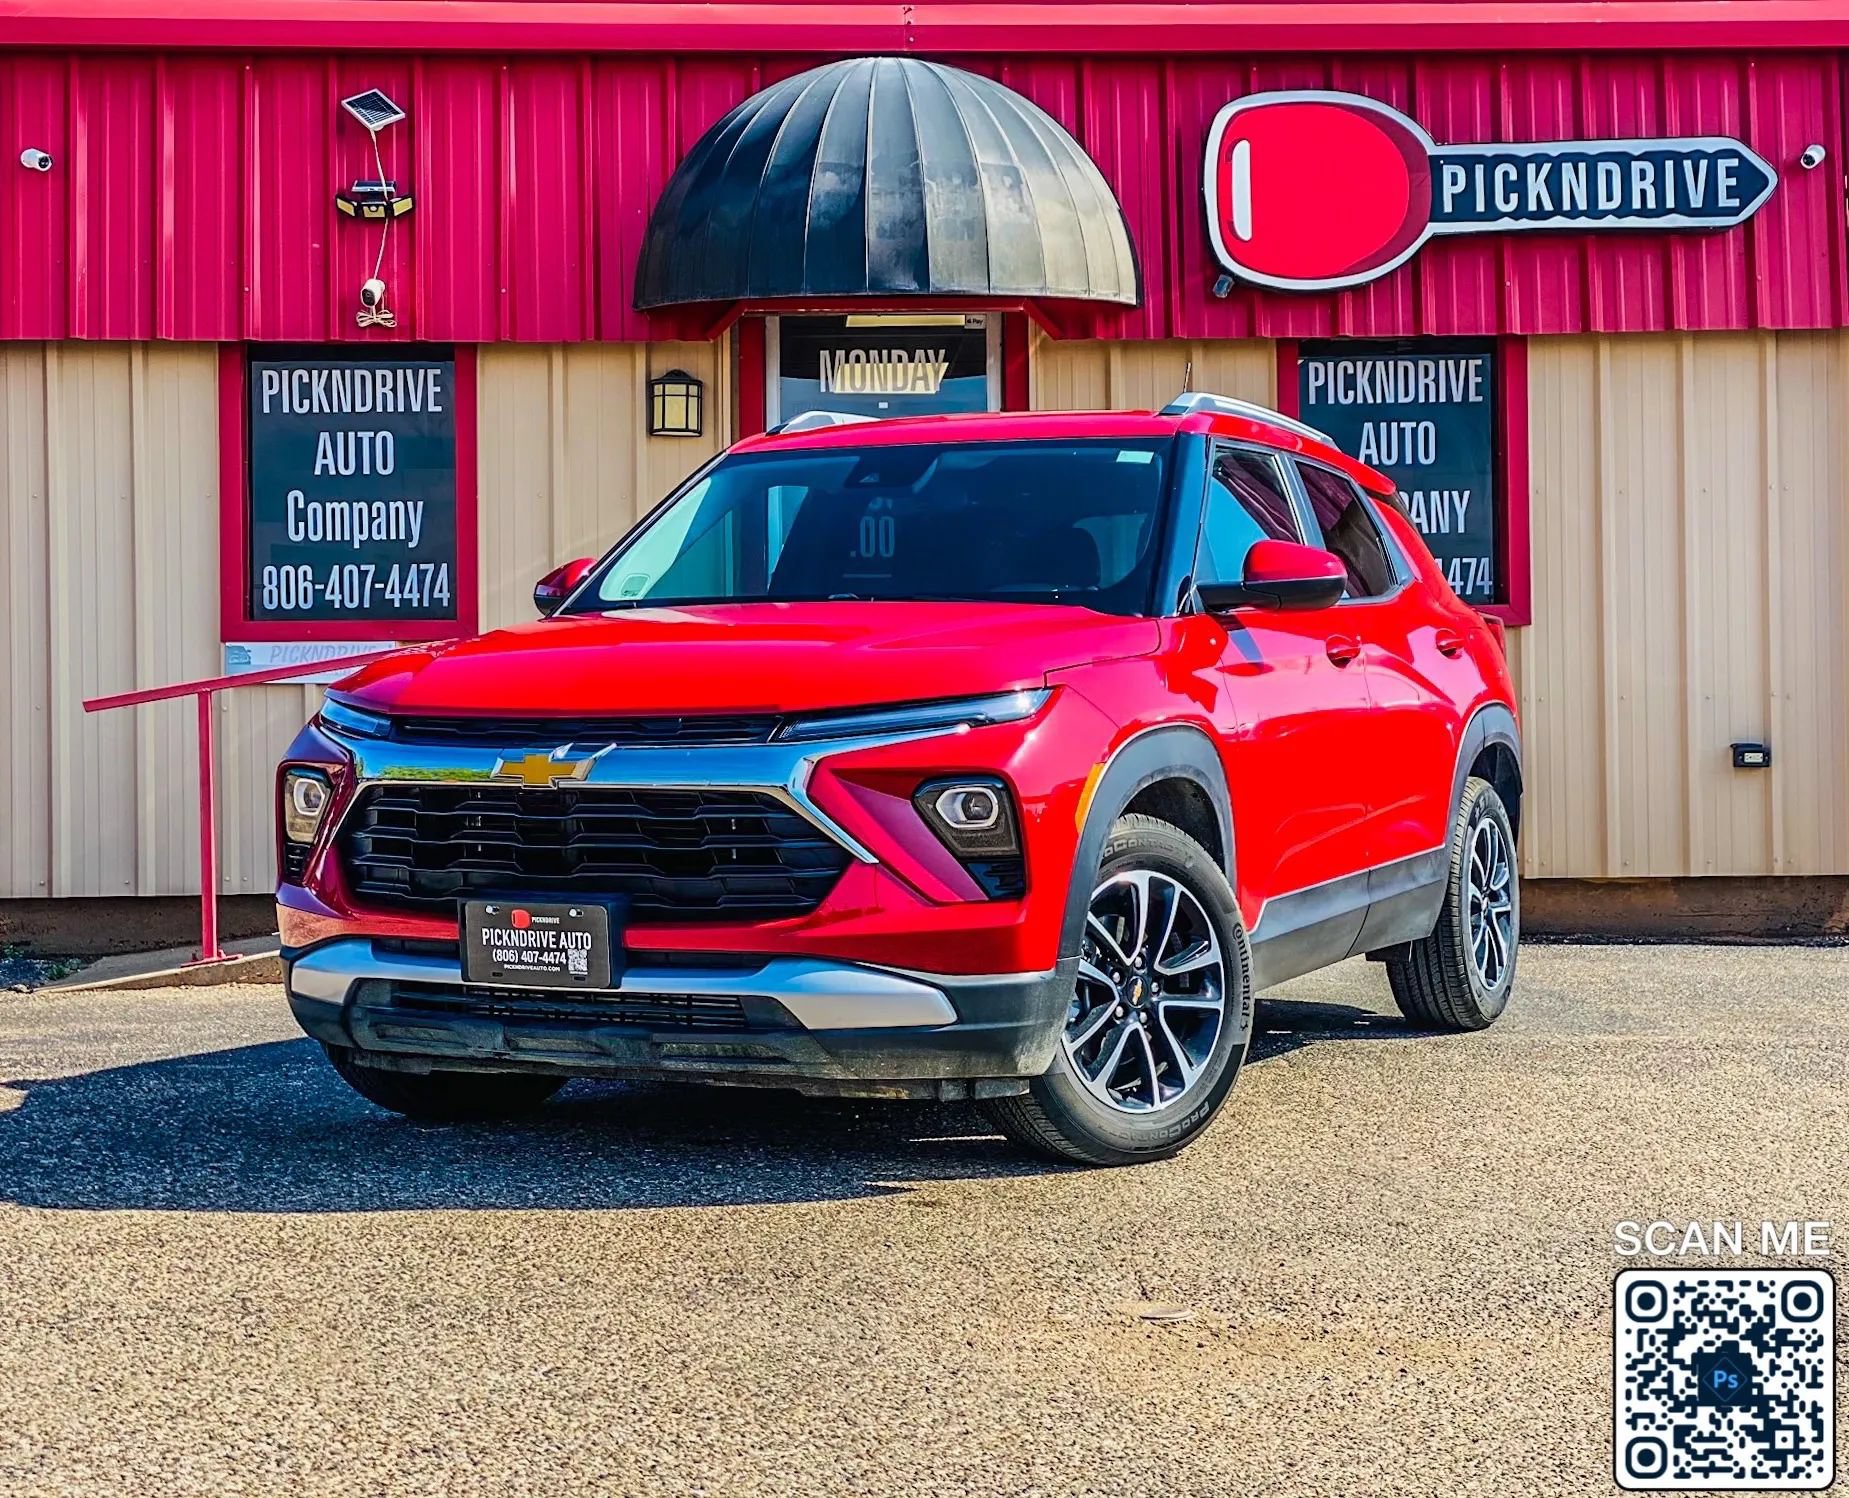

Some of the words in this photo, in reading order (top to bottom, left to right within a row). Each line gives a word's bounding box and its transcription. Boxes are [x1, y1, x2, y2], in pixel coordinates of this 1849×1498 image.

[1442, 158, 1740, 213] PICKNDRIVE
[261, 368, 443, 414] PICKNDRIVE
[819, 349, 946, 393] MONDAY
[1308, 359, 1483, 405] PICKNDRIVE
[314, 430, 395, 476] AUTO
[1358, 420, 1436, 466] AUTO
[287, 489, 424, 549] Company
[262, 562, 451, 610] 806-407-4474
[481, 927, 557, 949] PICKNDRIVE
[559, 931, 592, 950] AUTO
[531, 916, 560, 925] PICKNDRIVE
[492, 949, 519, 963] (806)
[521, 950, 567, 965] 407-4474
[504, 964, 561, 973] PICKNDRIVEAUTO.COM
[1232, 921, 1251, 1017] Continental
